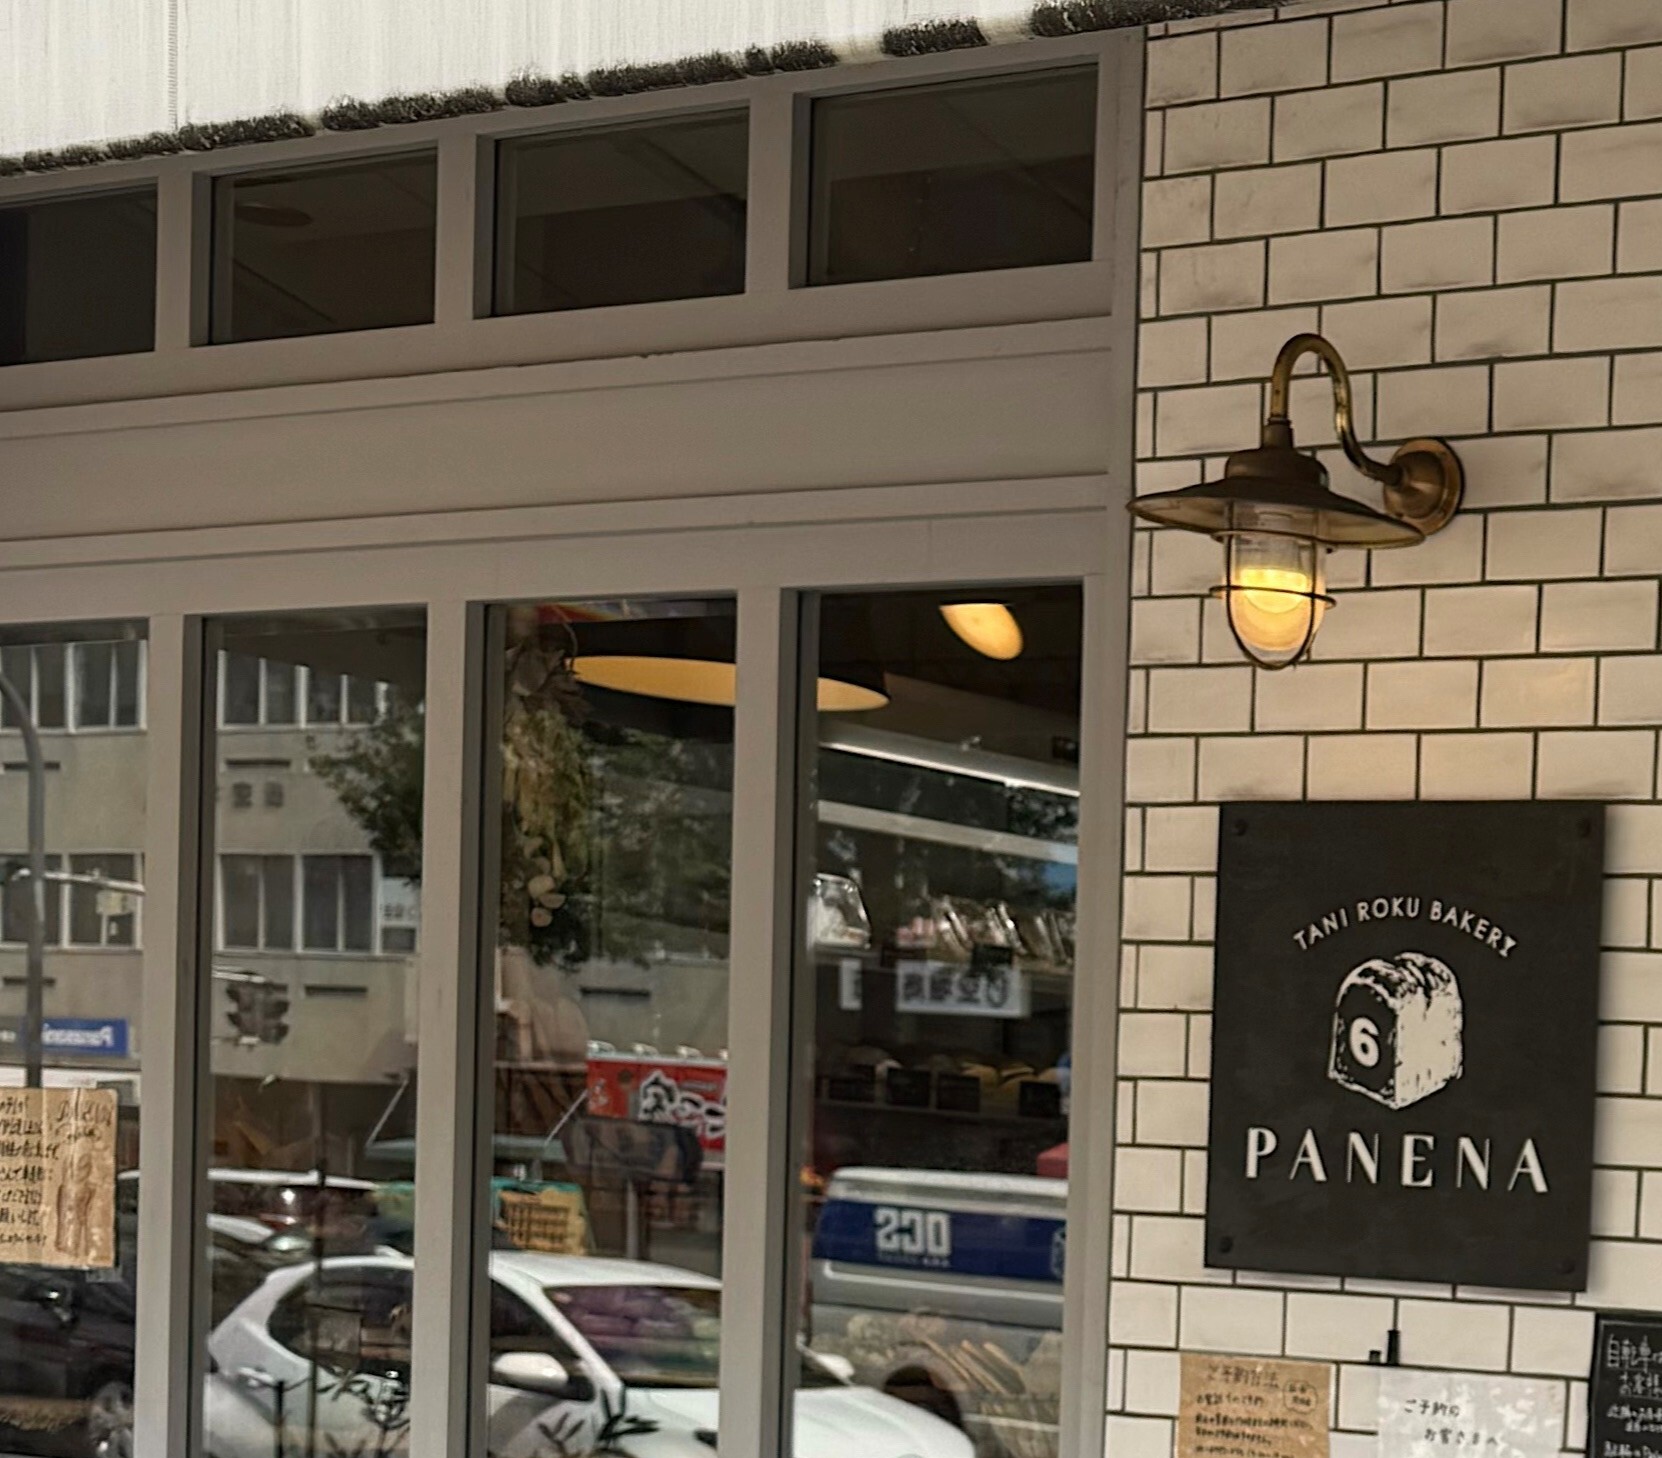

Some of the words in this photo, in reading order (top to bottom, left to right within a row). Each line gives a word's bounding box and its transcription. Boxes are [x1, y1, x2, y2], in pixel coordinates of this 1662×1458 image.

[1293, 908, 1349, 950] TANI
[1357, 897, 1421, 922] ROKU
[1430, 900, 1517, 958] BAKERY
[1350, 1016, 1380, 1068] 6
[1245, 1126, 1550, 1194] PANENA
[1404, 1399, 1461, 1418] ご予約の
[1424, 1427, 1499, 1446] お客さまへ
